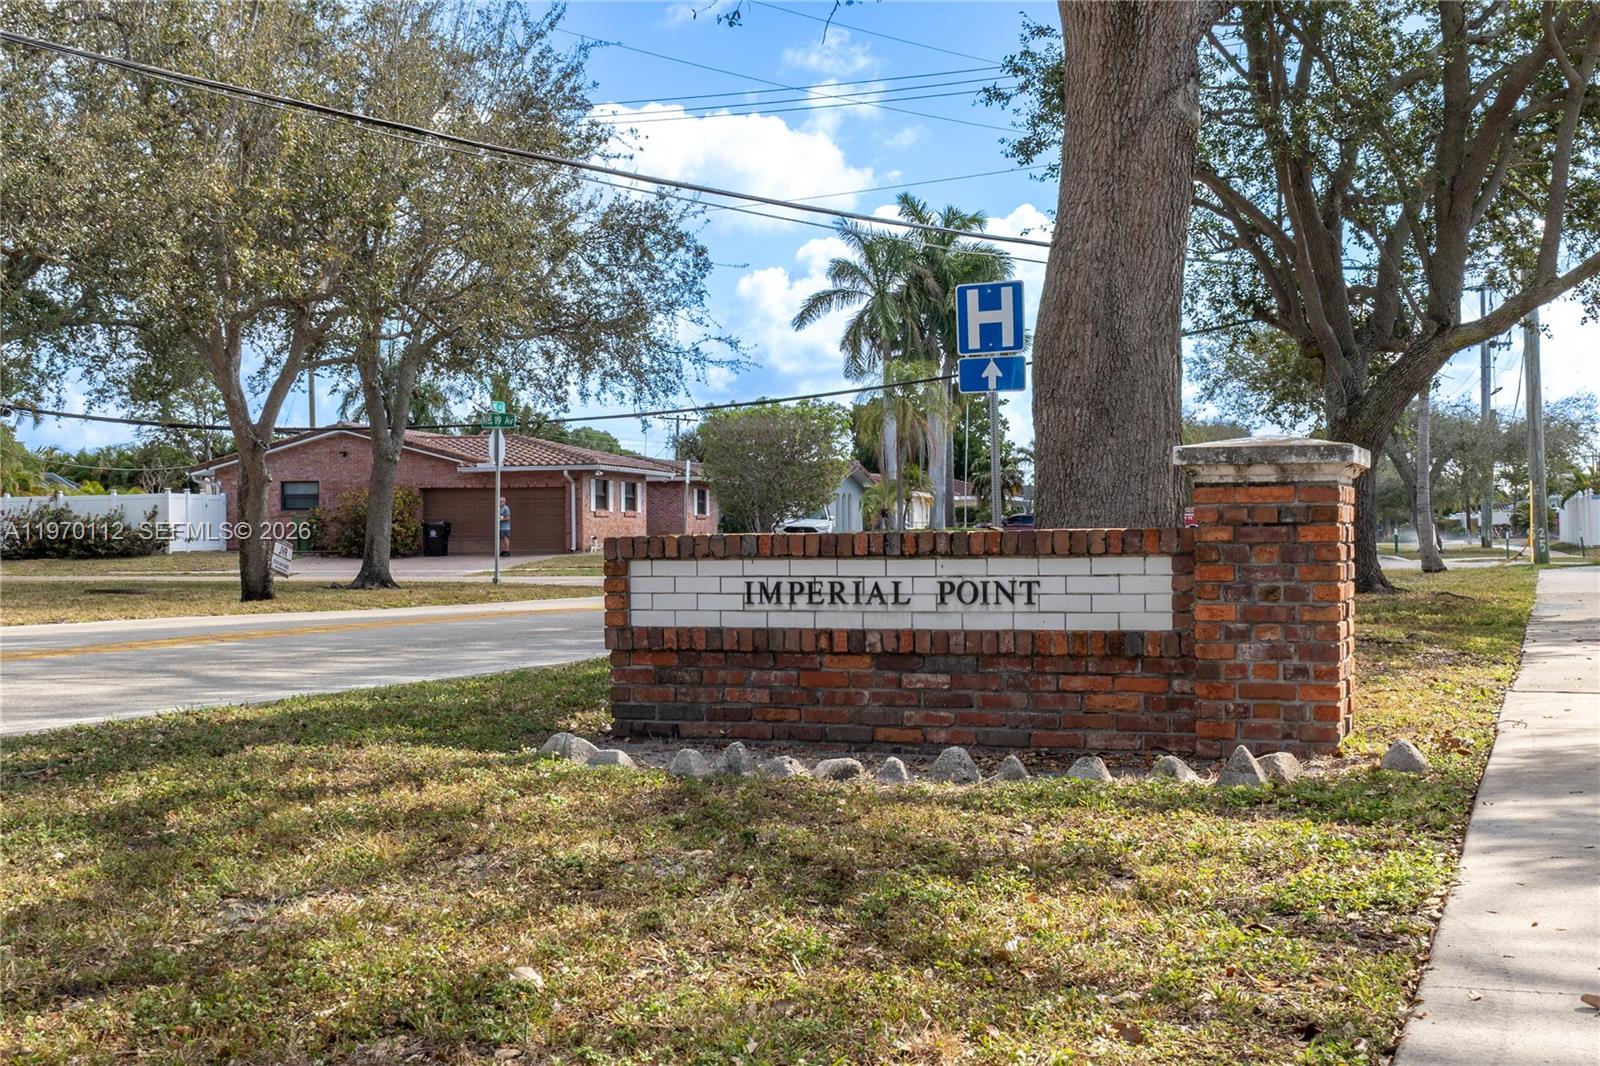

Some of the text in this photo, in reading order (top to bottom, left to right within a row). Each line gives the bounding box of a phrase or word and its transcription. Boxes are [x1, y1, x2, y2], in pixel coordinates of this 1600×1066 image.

[966, 286, 1014, 350] H
[494, 416, 502, 425] 19
[744, 580, 1041, 606] IMPERIAL POINT
